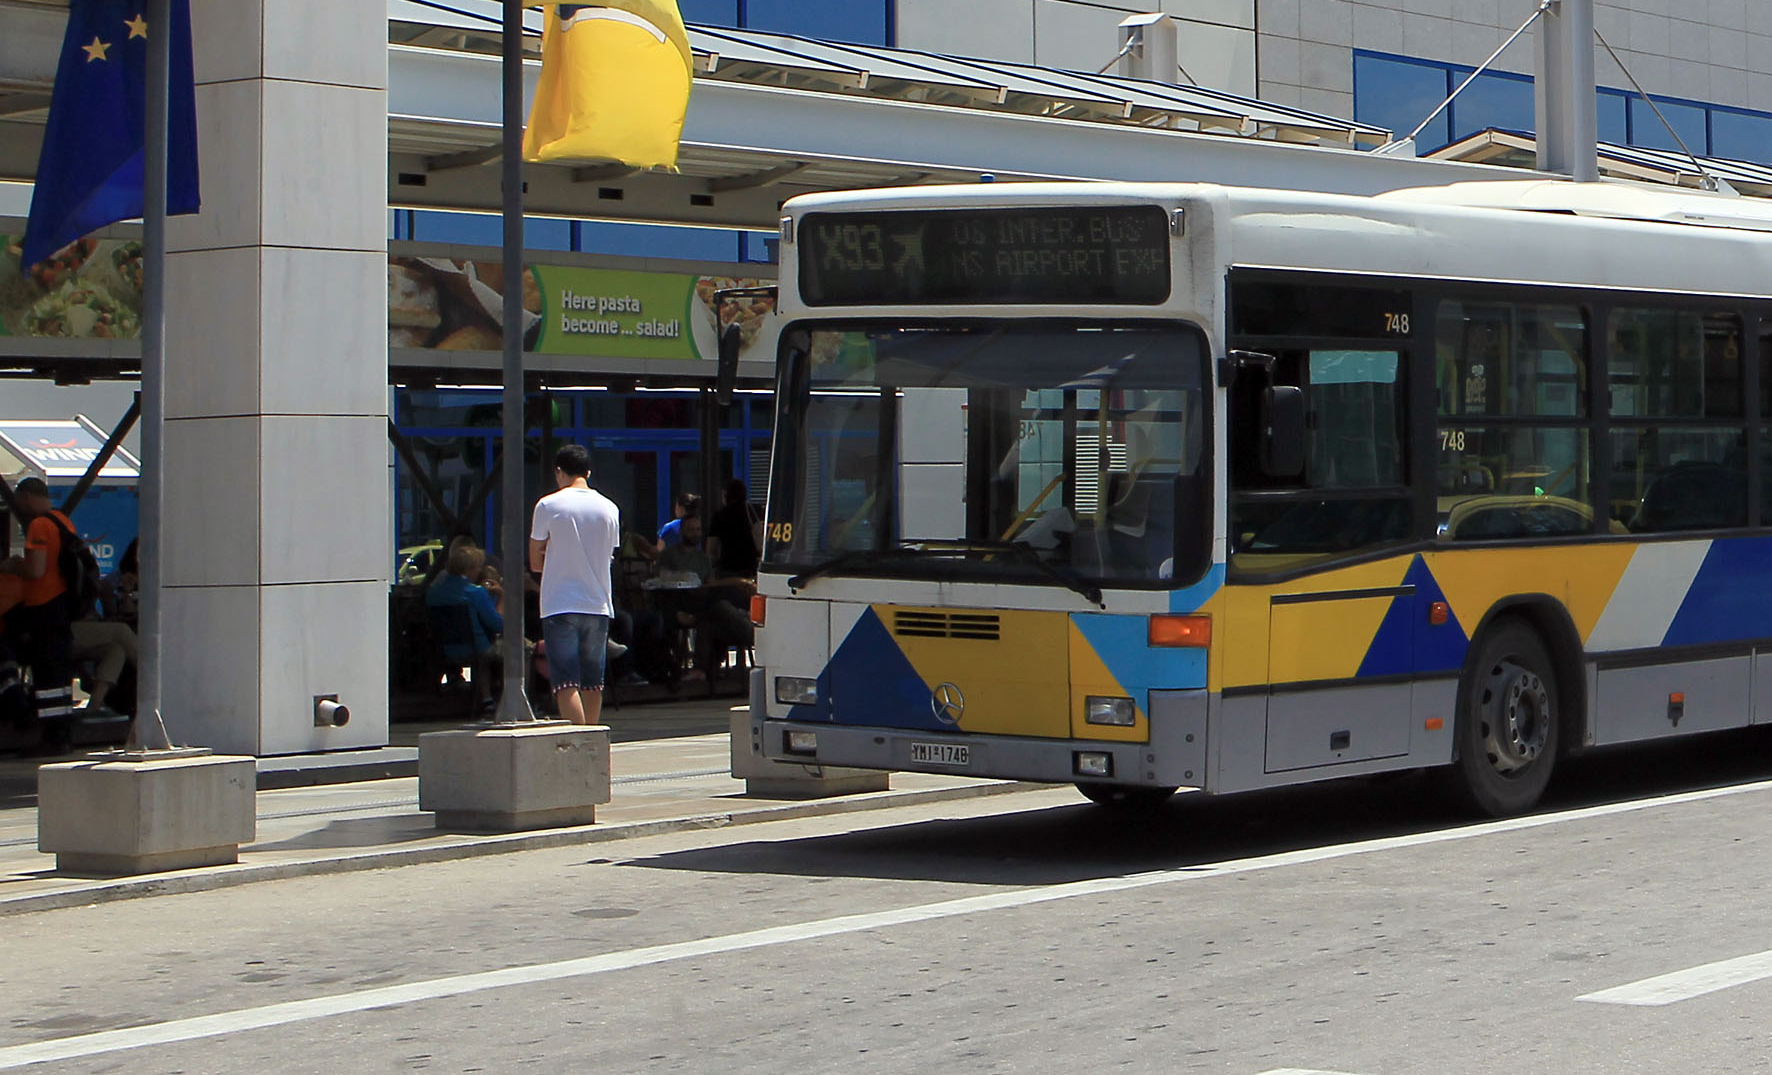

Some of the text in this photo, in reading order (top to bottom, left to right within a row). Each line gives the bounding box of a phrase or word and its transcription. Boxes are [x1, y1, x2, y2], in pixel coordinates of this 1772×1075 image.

[995, 249, 1104, 276] AIRPORT
[562, 290, 641, 315] Here pasta
[562, 314, 619, 334] become
[636, 318, 679, 337] salad!
[1384, 313, 1410, 334] 748
[1440, 431, 1465, 451] 748
[22, 448, 101, 461] WIND
[767, 523, 792, 542] 748
[89, 544, 114, 559] ND
